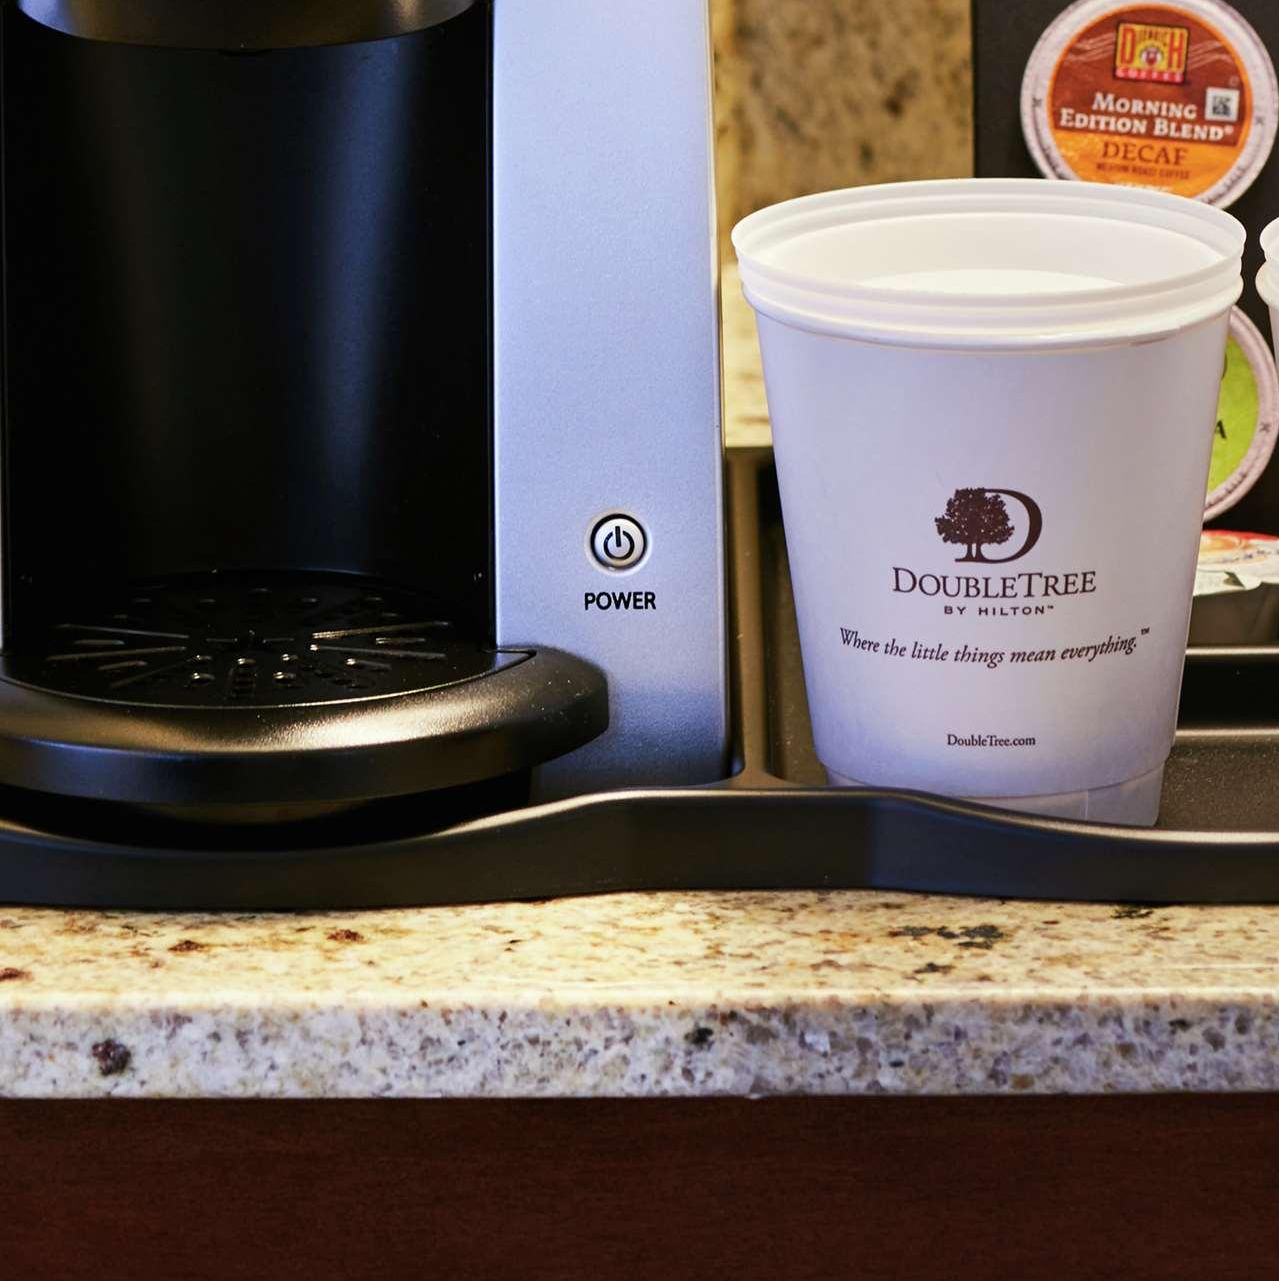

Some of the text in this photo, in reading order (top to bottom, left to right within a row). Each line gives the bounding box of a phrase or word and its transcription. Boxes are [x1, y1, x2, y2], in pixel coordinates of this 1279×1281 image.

[1092, 92, 1198, 120] MORNING
[1059, 108, 1147, 135] EDITION
[1101, 140, 1189, 166] DECAF
[892, 567, 1097, 599] DOUBLETREE
[584, 591, 657, 611] POWER
[944, 605, 967, 615] BY
[839, 627, 881, 653] Where
[884, 638, 907, 658] the
[911, 641, 950, 662] little
[953, 645, 1005, 669] things
[1010, 648, 1056, 663] mean
[947, 733, 1037, 747] DoubleTree.com
